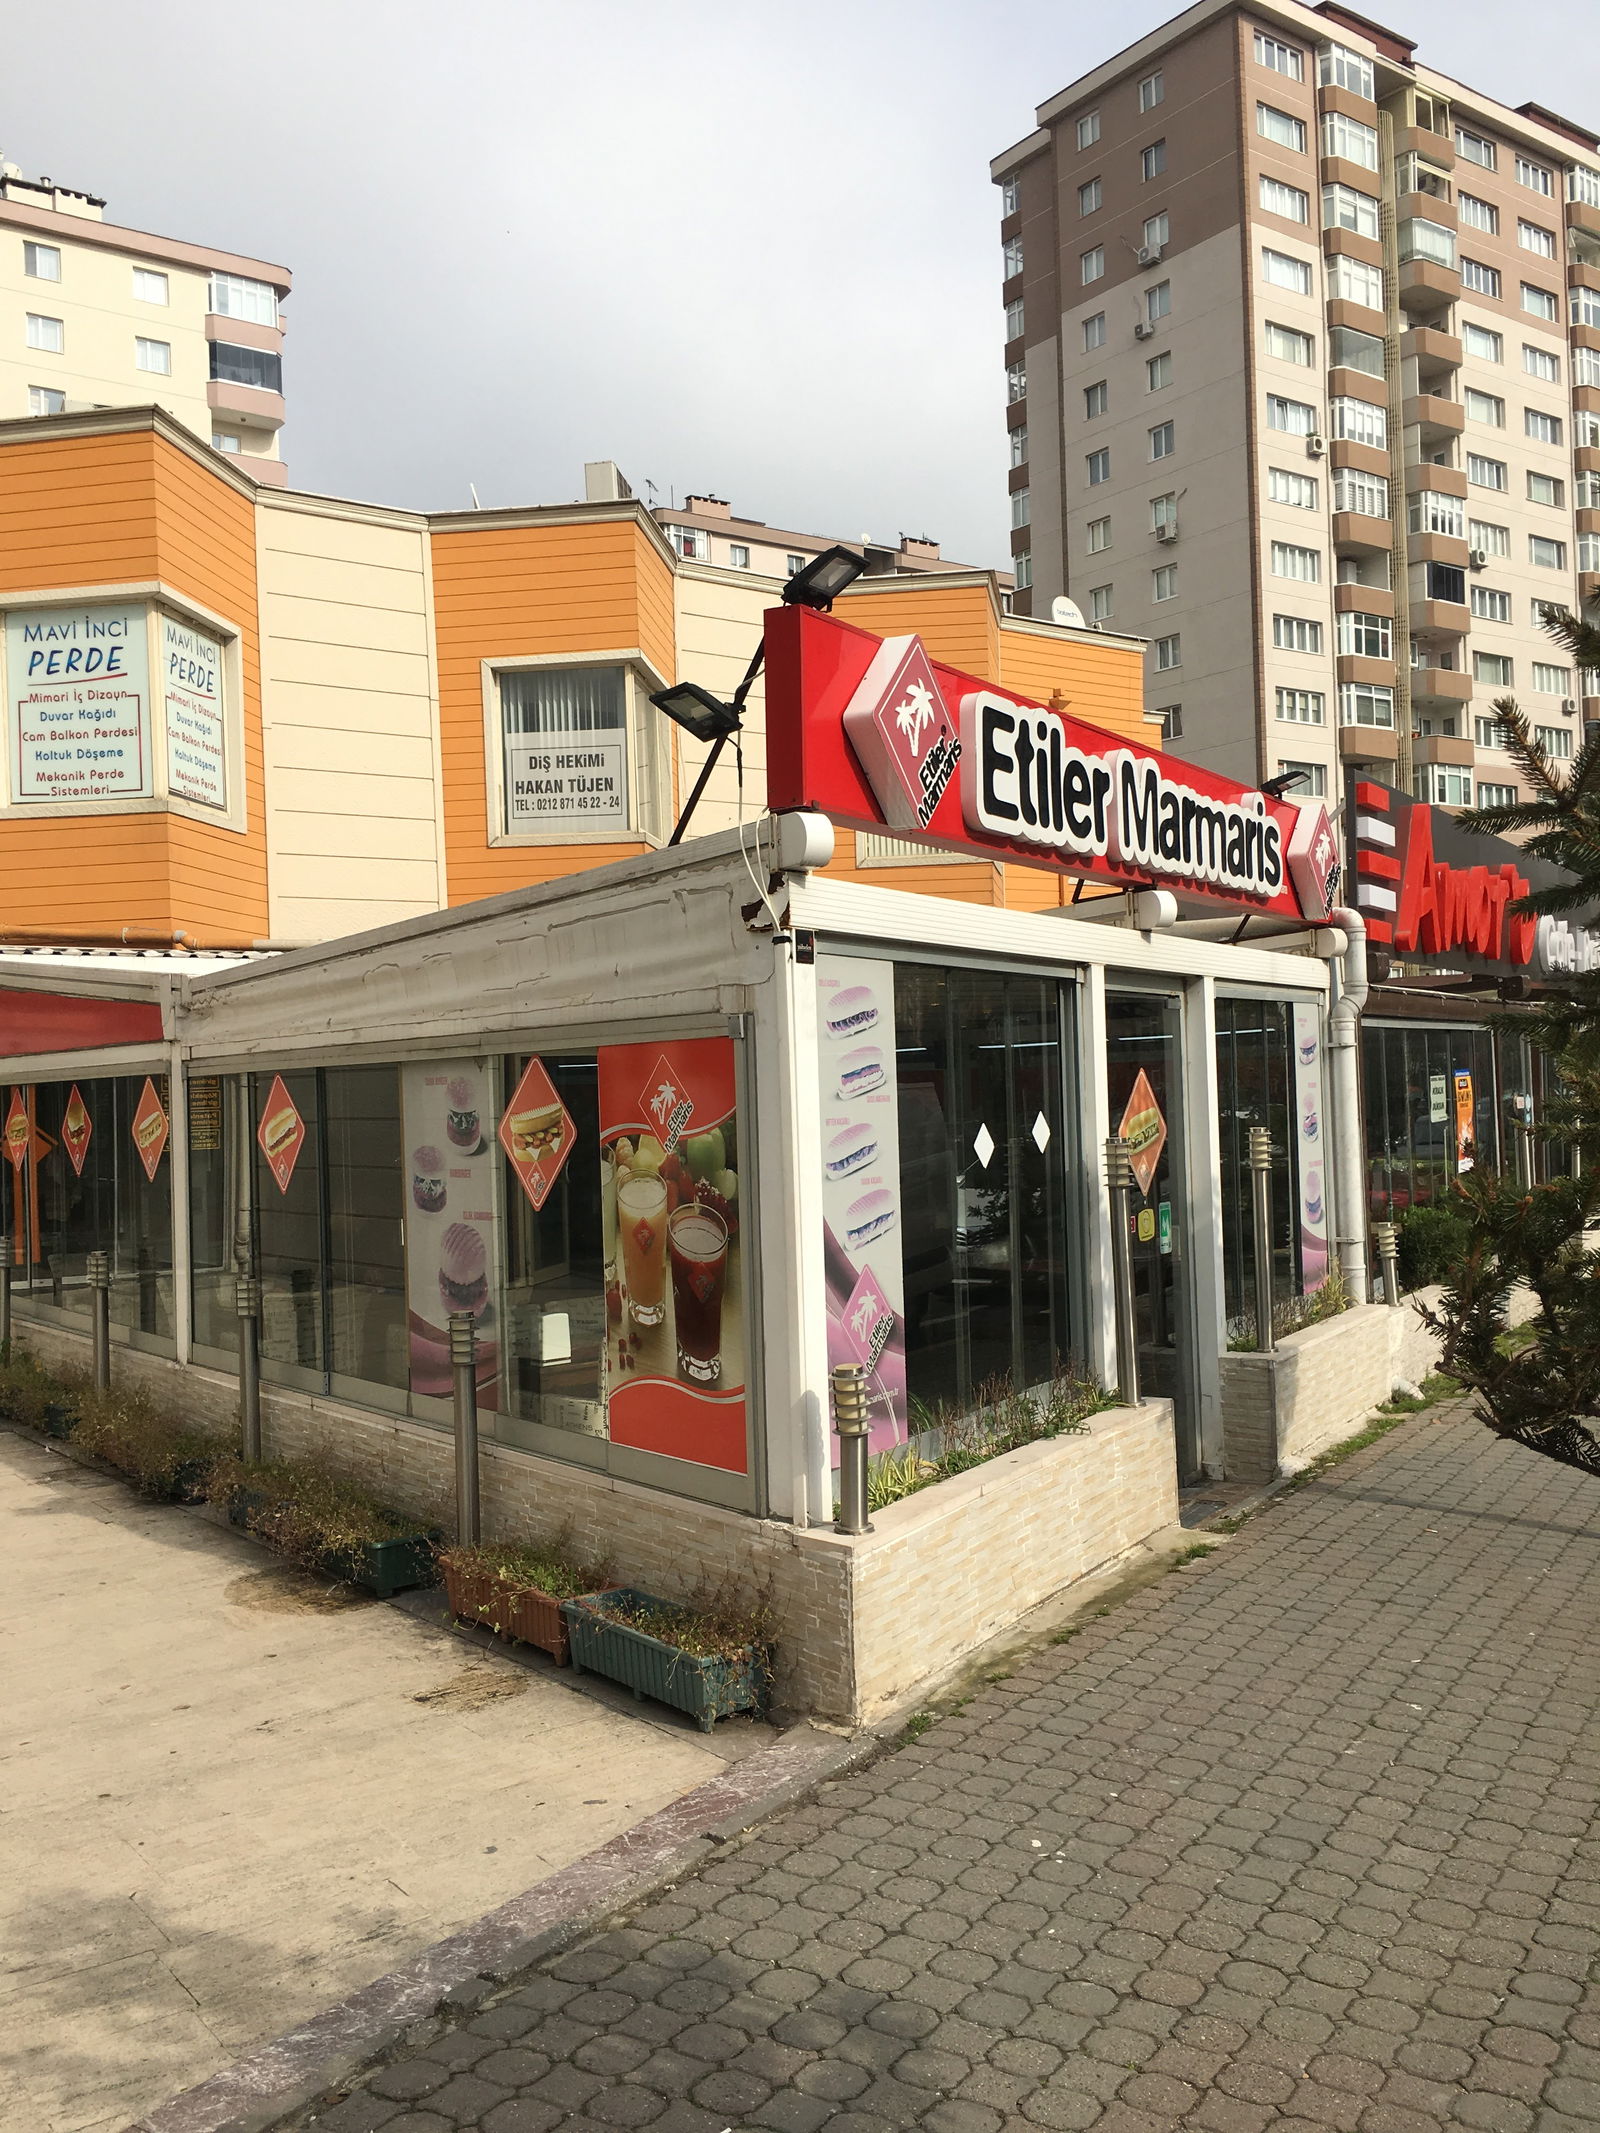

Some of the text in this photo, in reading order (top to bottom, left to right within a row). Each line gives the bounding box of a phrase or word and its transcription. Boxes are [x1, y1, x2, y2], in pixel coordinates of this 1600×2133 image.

[28, 646, 124, 676] PERDE
[170, 652, 214, 692] PERDE
[29, 689, 128, 703] Mimari İç Dizayn
[40, 708, 116, 722] Duvar Kağıdı
[22, 726, 138, 741] Cam Balkon Perdesi
[35, 748, 124, 761] Koltuk Döşeme
[917, 736, 948, 794] Etiler
[36, 769, 124, 782] Mekanik Perde
[51, 784, 109, 796] Sistemleri
[515, 775, 614, 795] HAKAN TÜJEN
[917, 737, 962, 828] Marmaris
[536, 797, 558, 811] 0212
[559, 797, 575, 810] 871
[577, 797, 588, 809] 45
[590, 796, 601, 809] 22
[609, 795, 620, 808] 24
[982, 704, 1281, 887] Etiler Marmaris
[664, 1101, 694, 1152] Marmaris
[667, 1101, 685, 1132] Etiler
[865, 1313, 894, 1372] Marmaris
[868, 1315, 886, 1348] Etiler
